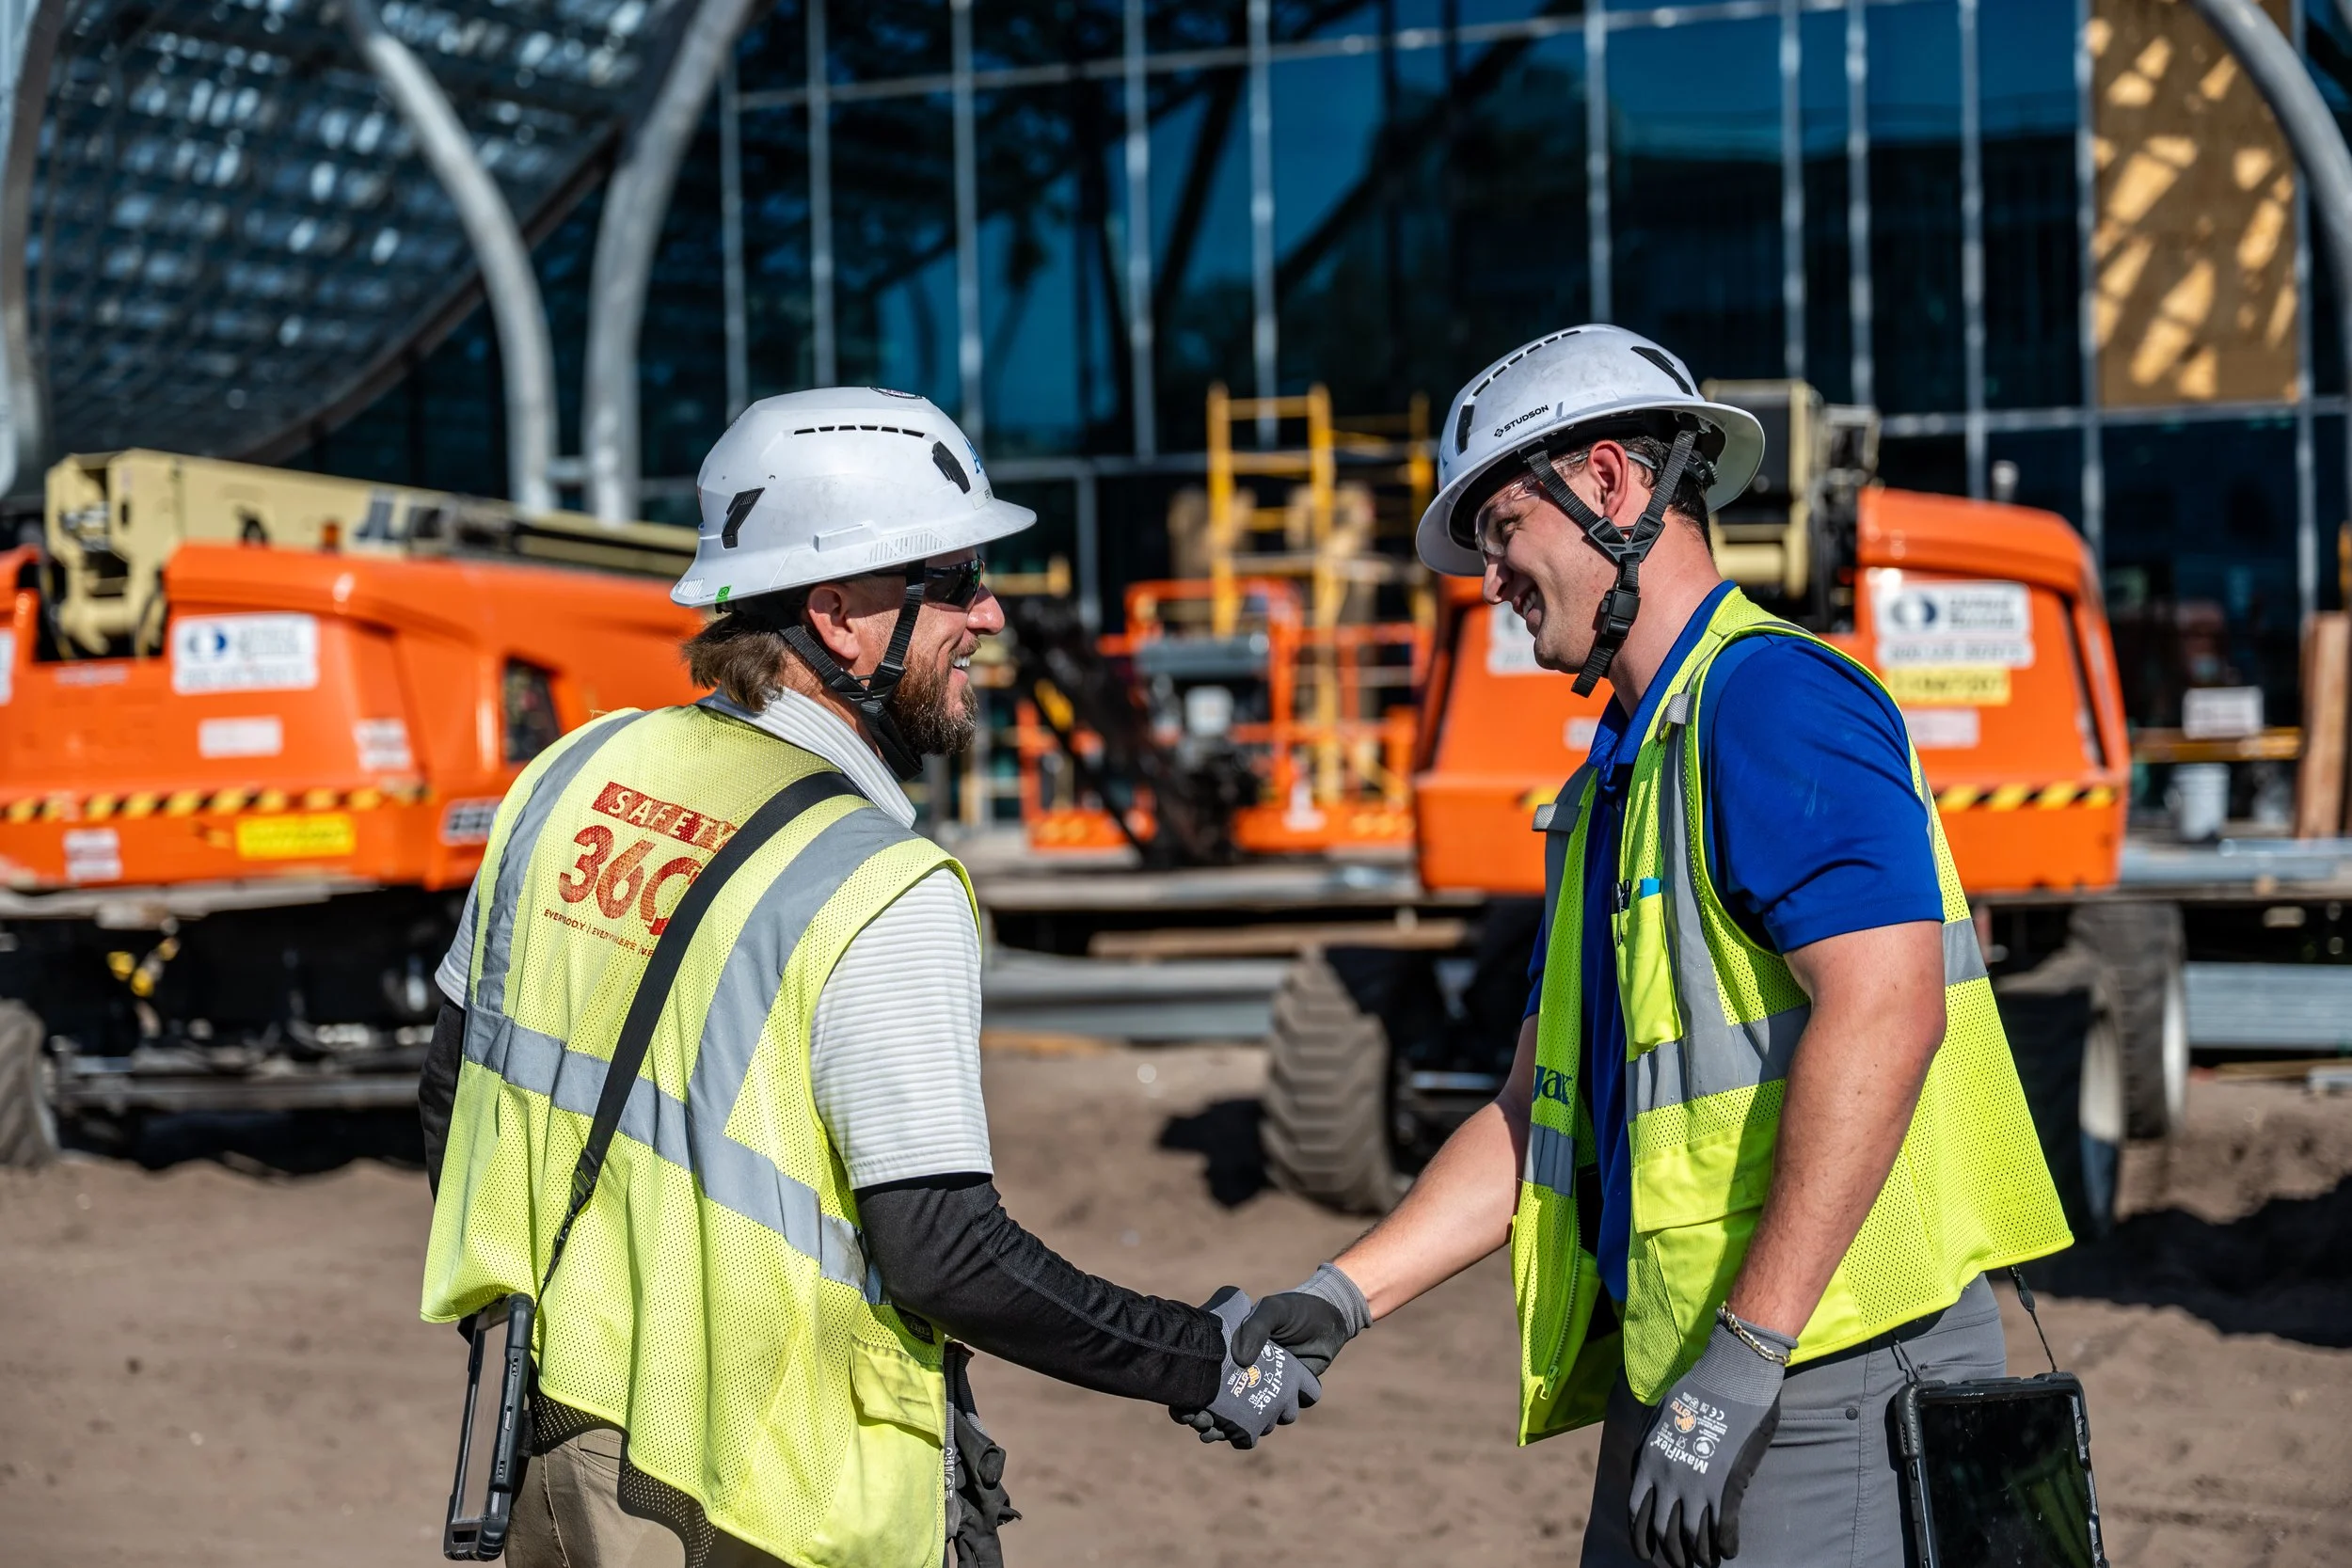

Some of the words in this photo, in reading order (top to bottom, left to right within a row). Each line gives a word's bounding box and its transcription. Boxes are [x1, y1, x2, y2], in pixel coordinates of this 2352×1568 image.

[1504, 404, 1549, 432] STUDSON
[608, 791, 735, 850] SAFETY
[1257, 1345, 1286, 1410] MaxiFlex
[1654, 1434, 1709, 1475] MaxiFlex
